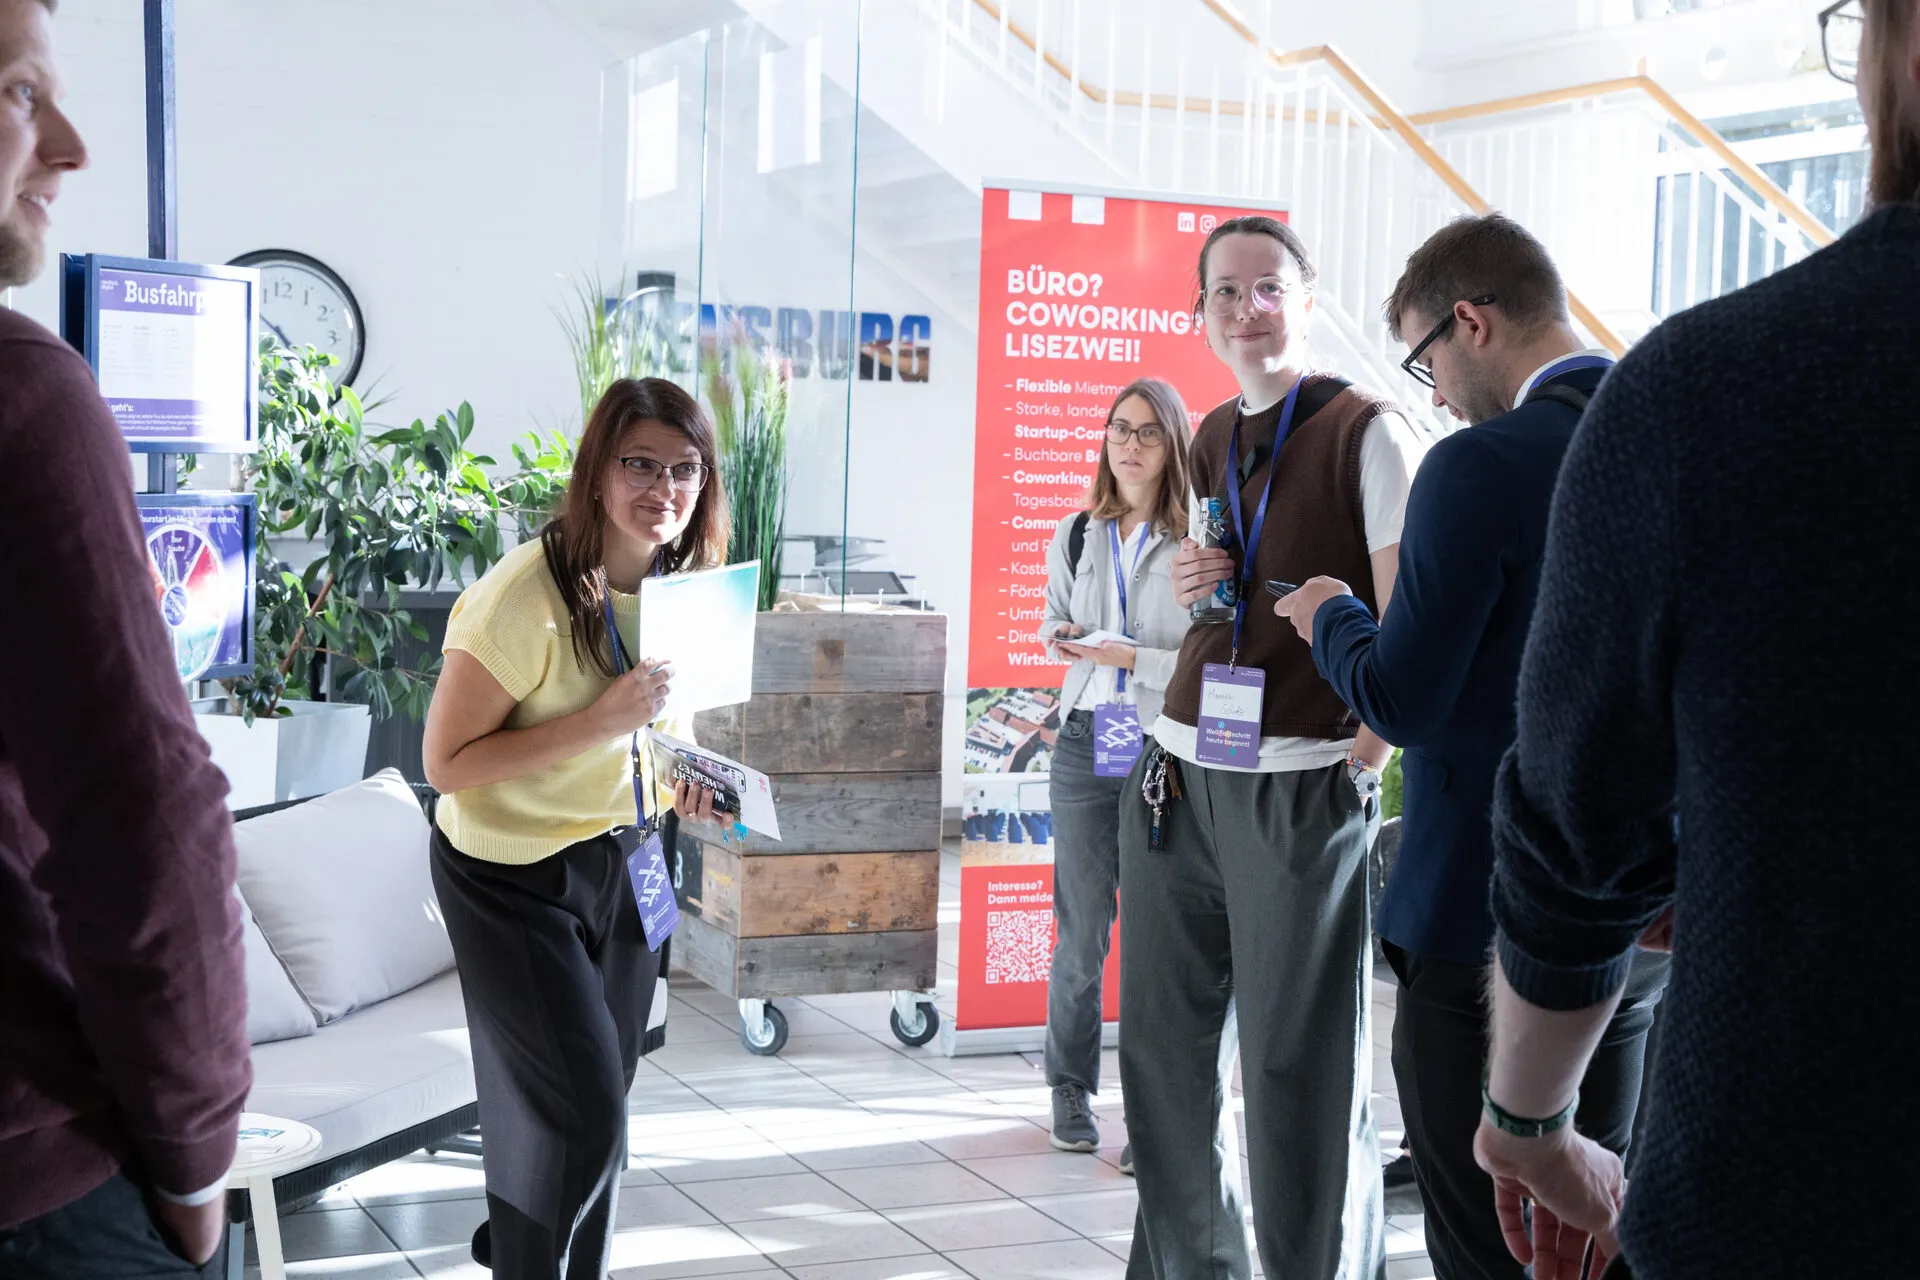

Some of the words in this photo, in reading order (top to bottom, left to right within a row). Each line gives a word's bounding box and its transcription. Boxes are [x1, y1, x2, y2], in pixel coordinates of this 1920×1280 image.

[1007, 264, 1103, 298] BÜRO?
[274, 281, 293, 298] 12
[317, 305, 328, 322] 2
[327, 329, 338, 345] 3
[1005, 332, 1141, 363] LISEZWEI!
[1016, 378, 1072, 394] Flexible
[1016, 401, 1064, 417] Starke,
[1014, 448, 1083, 463] Buchbare
[1013, 470, 1092, 488] Coworking
[1011, 538, 1038, 552] und
[1205, 736, 1223, 744] heute
[678, 761, 718, 790] HEUTE?
[987, 879, 1043, 892] Interesse?
[987, 893, 1017, 905] Dann
